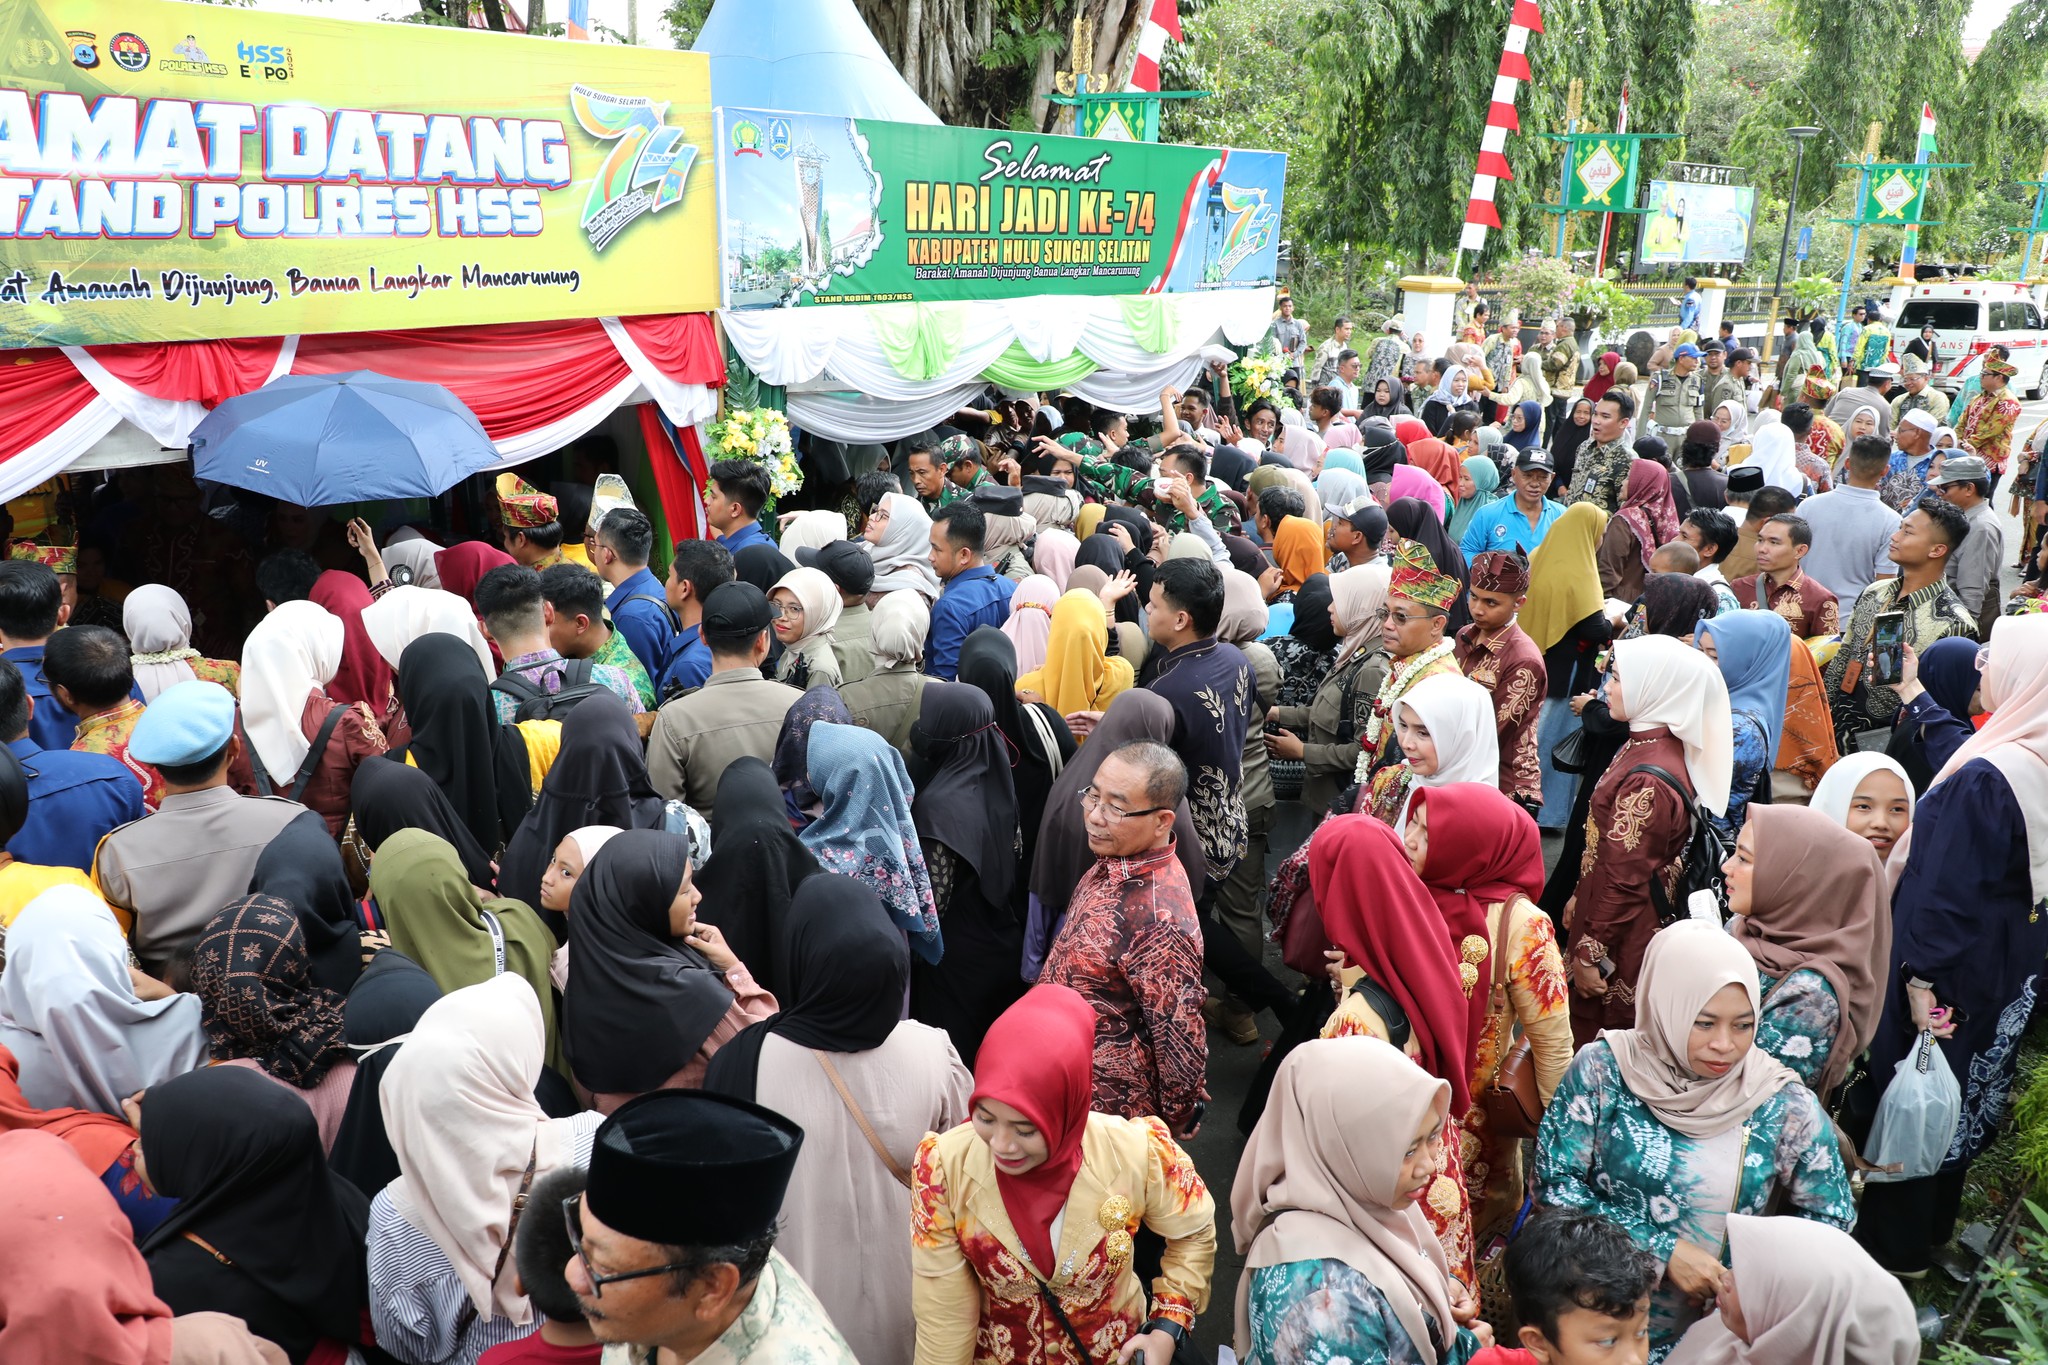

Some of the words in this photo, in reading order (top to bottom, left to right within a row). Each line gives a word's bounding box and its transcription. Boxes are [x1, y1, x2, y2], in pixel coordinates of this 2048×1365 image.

[236, 40, 285, 65] HSS
[159, 60, 203, 73] POLRES
[203, 62, 228, 76] HSS
[574, 85, 593, 98] HULU
[592, 92, 618, 104] SUNGAI
[618, 97, 647, 106] SELATAN
[262, 105, 572, 190] DATANG
[979, 140, 1112, 184] Selamat
[189, 182, 432, 239] POLRES
[435, 186, 544, 237] HSS
[906, 181, 991, 233] HARI
[1000, 185, 1071, 234] JADI
[1078, 189, 1156, 235] KE-74
[907, 238, 999, 265] KABUPATEN
[1003, 239, 1041, 265] HULU
[1044, 239, 1095, 264] SUNGAI
[1098, 239, 1151, 263] SELATAN
[41, 268, 151, 304] Amanah
[160, 269, 280, 306] Dijunjung,
[286, 267, 362, 297] Banua
[369, 264, 453, 299] Langkar
[461, 263, 581, 292] Mancarunung
[915, 267, 951, 280] Barakat
[953, 266, 989, 279] Amanah
[990, 266, 1031, 281] Dijunjung
[1033, 266, 1058, 277] Banua
[1060, 265, 1091, 279] Langkar
[1092, 266, 1141, 277] Mancarunung
[814, 295, 842, 304] STAND
[844, 294, 871, 302] KODIM
[254, 458, 269, 468] UV
